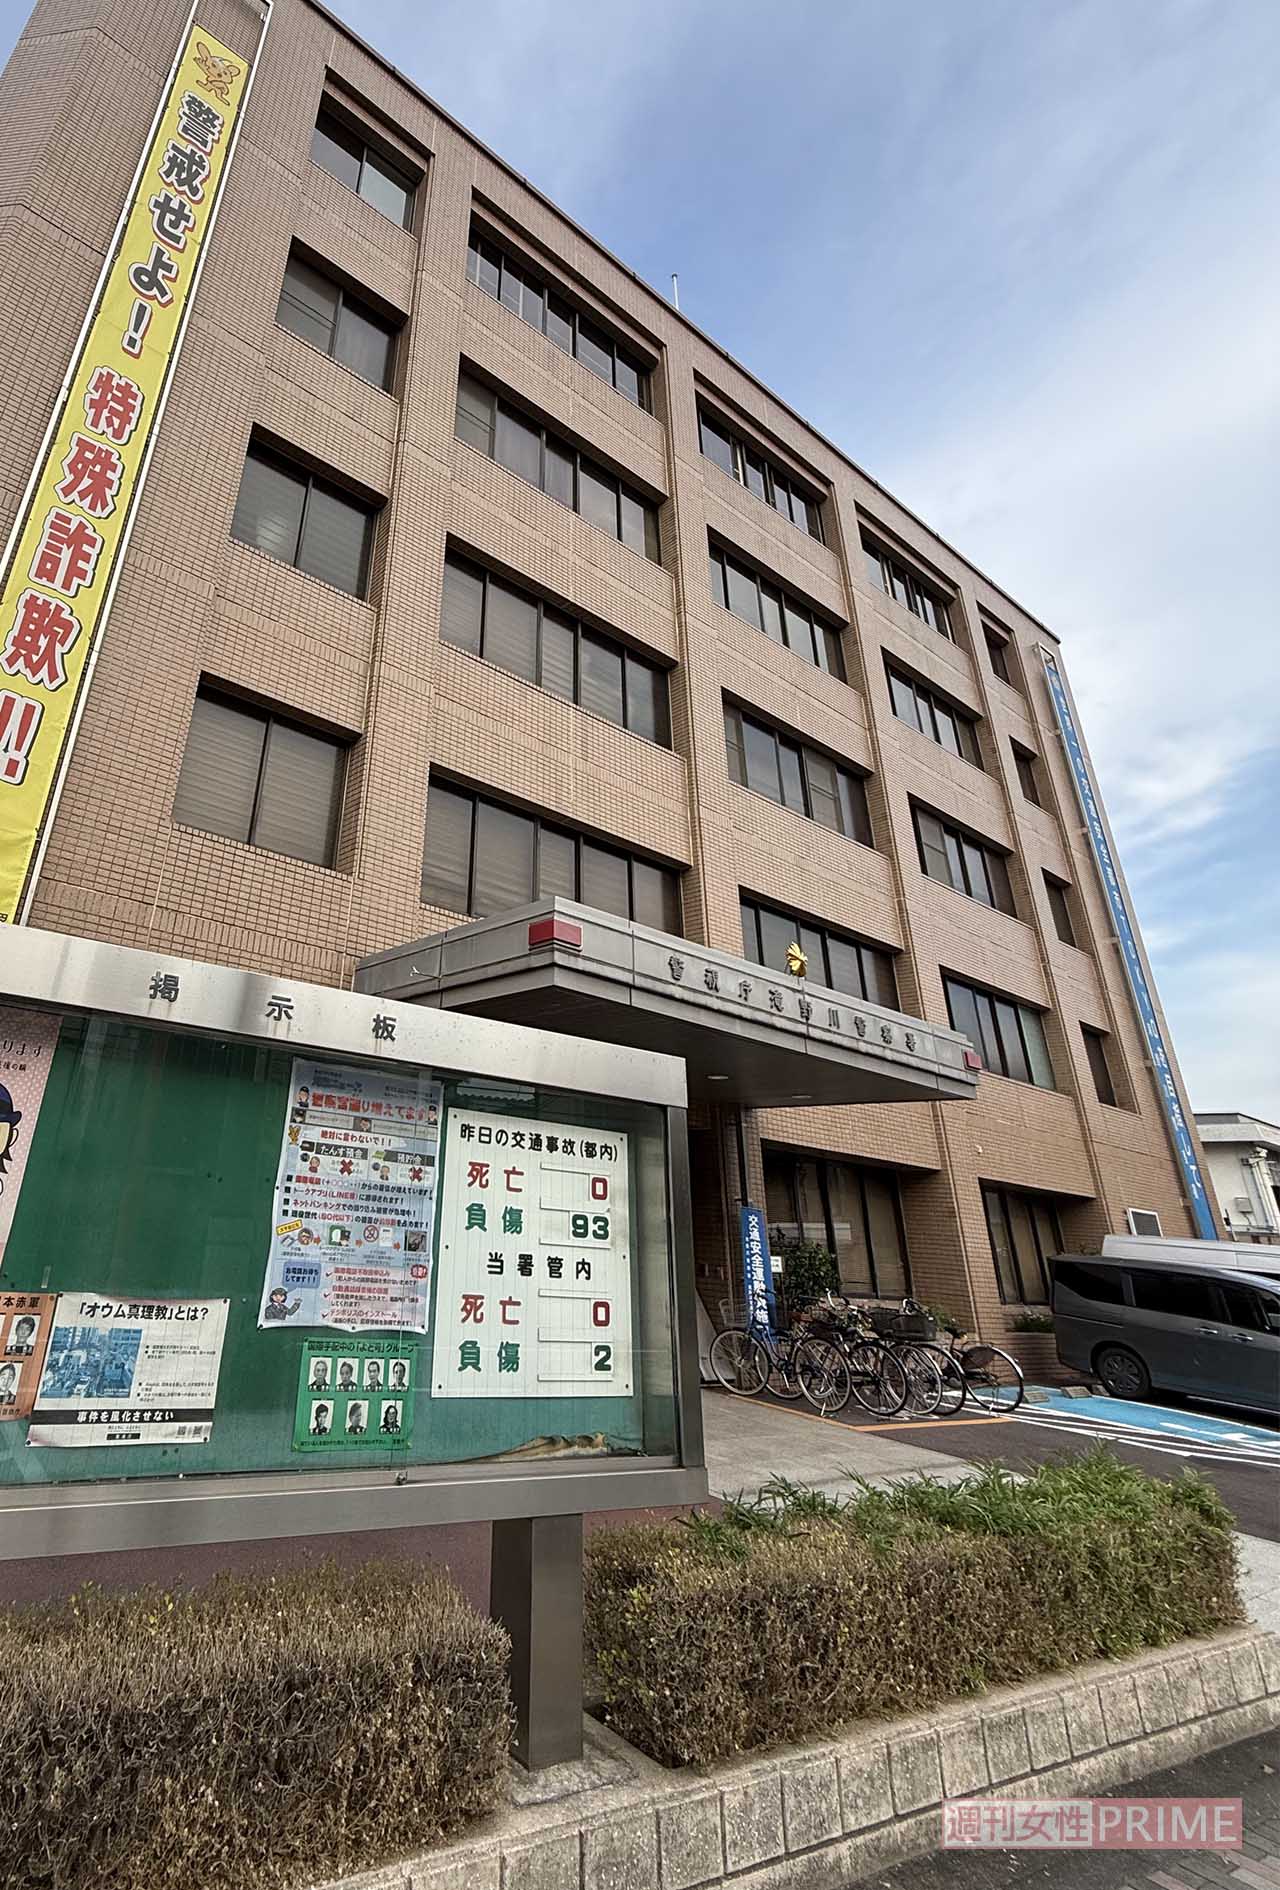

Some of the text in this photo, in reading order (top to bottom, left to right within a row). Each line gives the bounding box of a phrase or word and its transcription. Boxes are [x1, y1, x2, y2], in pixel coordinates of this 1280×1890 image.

[149, 972, 398, 1042] 掲示板
[460, 1123, 619, 1162] 昨日の交通事故(都内)
[467, 1161, 608, 1201] 死亡 0
[464, 1202, 610, 1240] 負傷 93
[486, 1252, 592, 1281] 当署管内
[0, 1296, 41, 1309] 本赤軍
[79, 1301, 209, 1322] 「オウム真理教」とは？
[460, 1293, 611, 1327] 死亡 0
[458, 1340, 612, 1373] 負傷 2
[77, 1410, 175, 1423] 事件を風化させない
